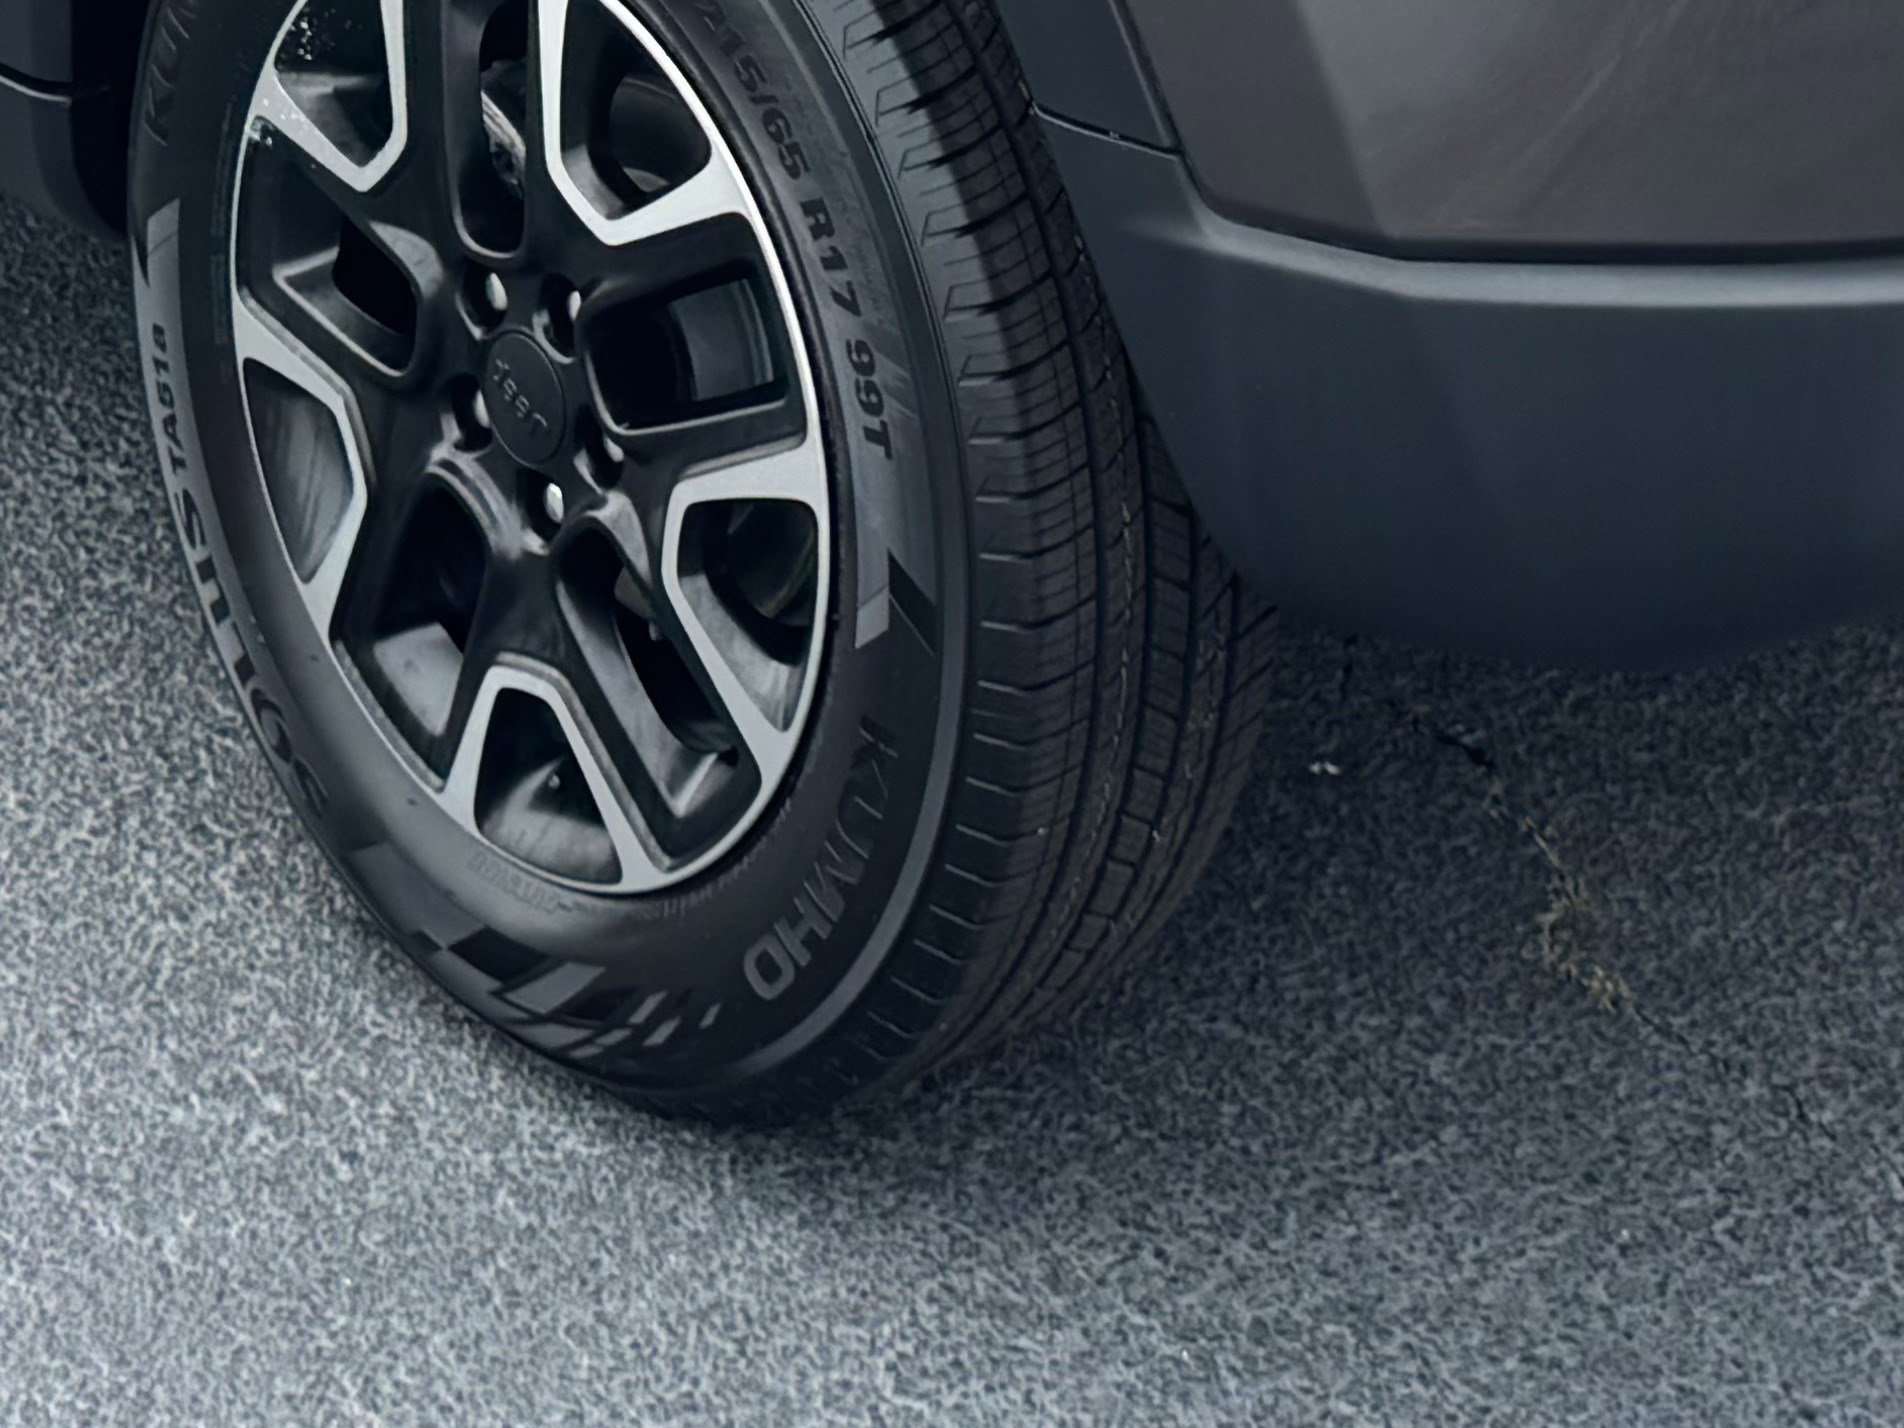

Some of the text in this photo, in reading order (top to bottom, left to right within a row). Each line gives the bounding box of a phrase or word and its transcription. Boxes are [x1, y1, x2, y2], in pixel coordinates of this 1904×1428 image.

[799, 197, 863, 318] R17
[845, 337, 894, 462] 99T
[743, 712, 899, 1002] KUMHO
